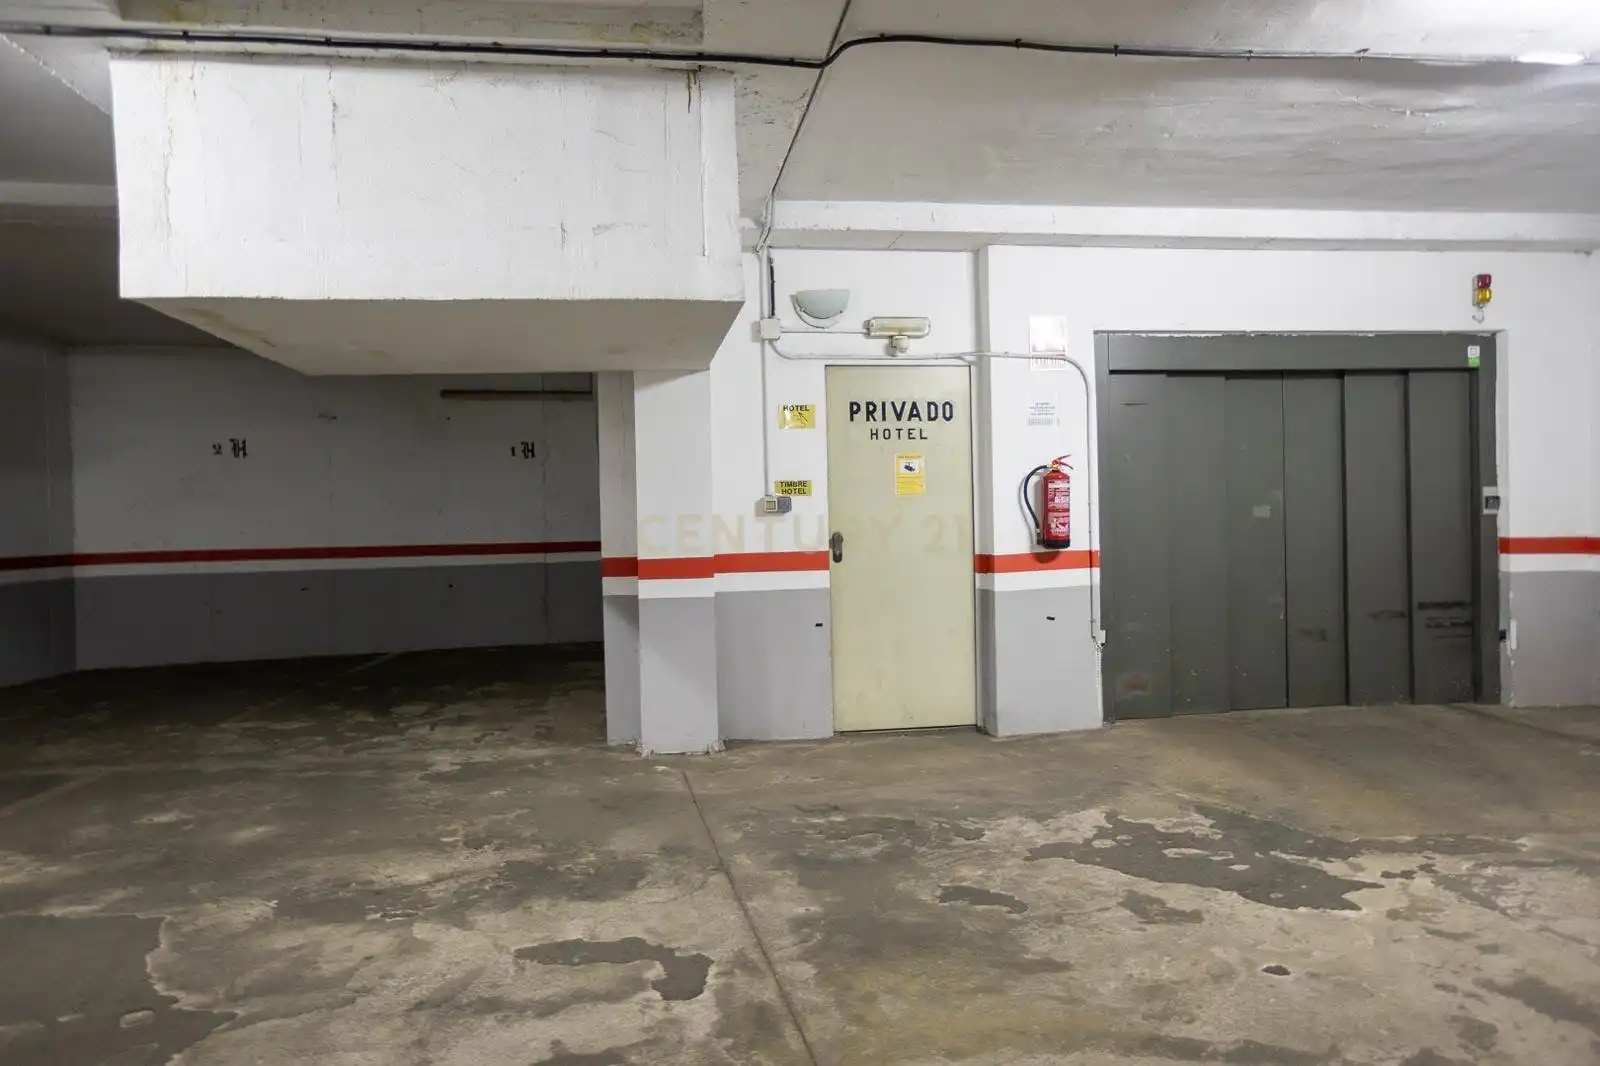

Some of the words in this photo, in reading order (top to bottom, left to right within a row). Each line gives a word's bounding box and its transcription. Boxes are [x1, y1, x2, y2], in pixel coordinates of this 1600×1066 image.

[783, 404, 809, 412] HOTEL
[849, 401, 954, 422] PRIVADO
[870, 428, 928, 440] HOTEL
